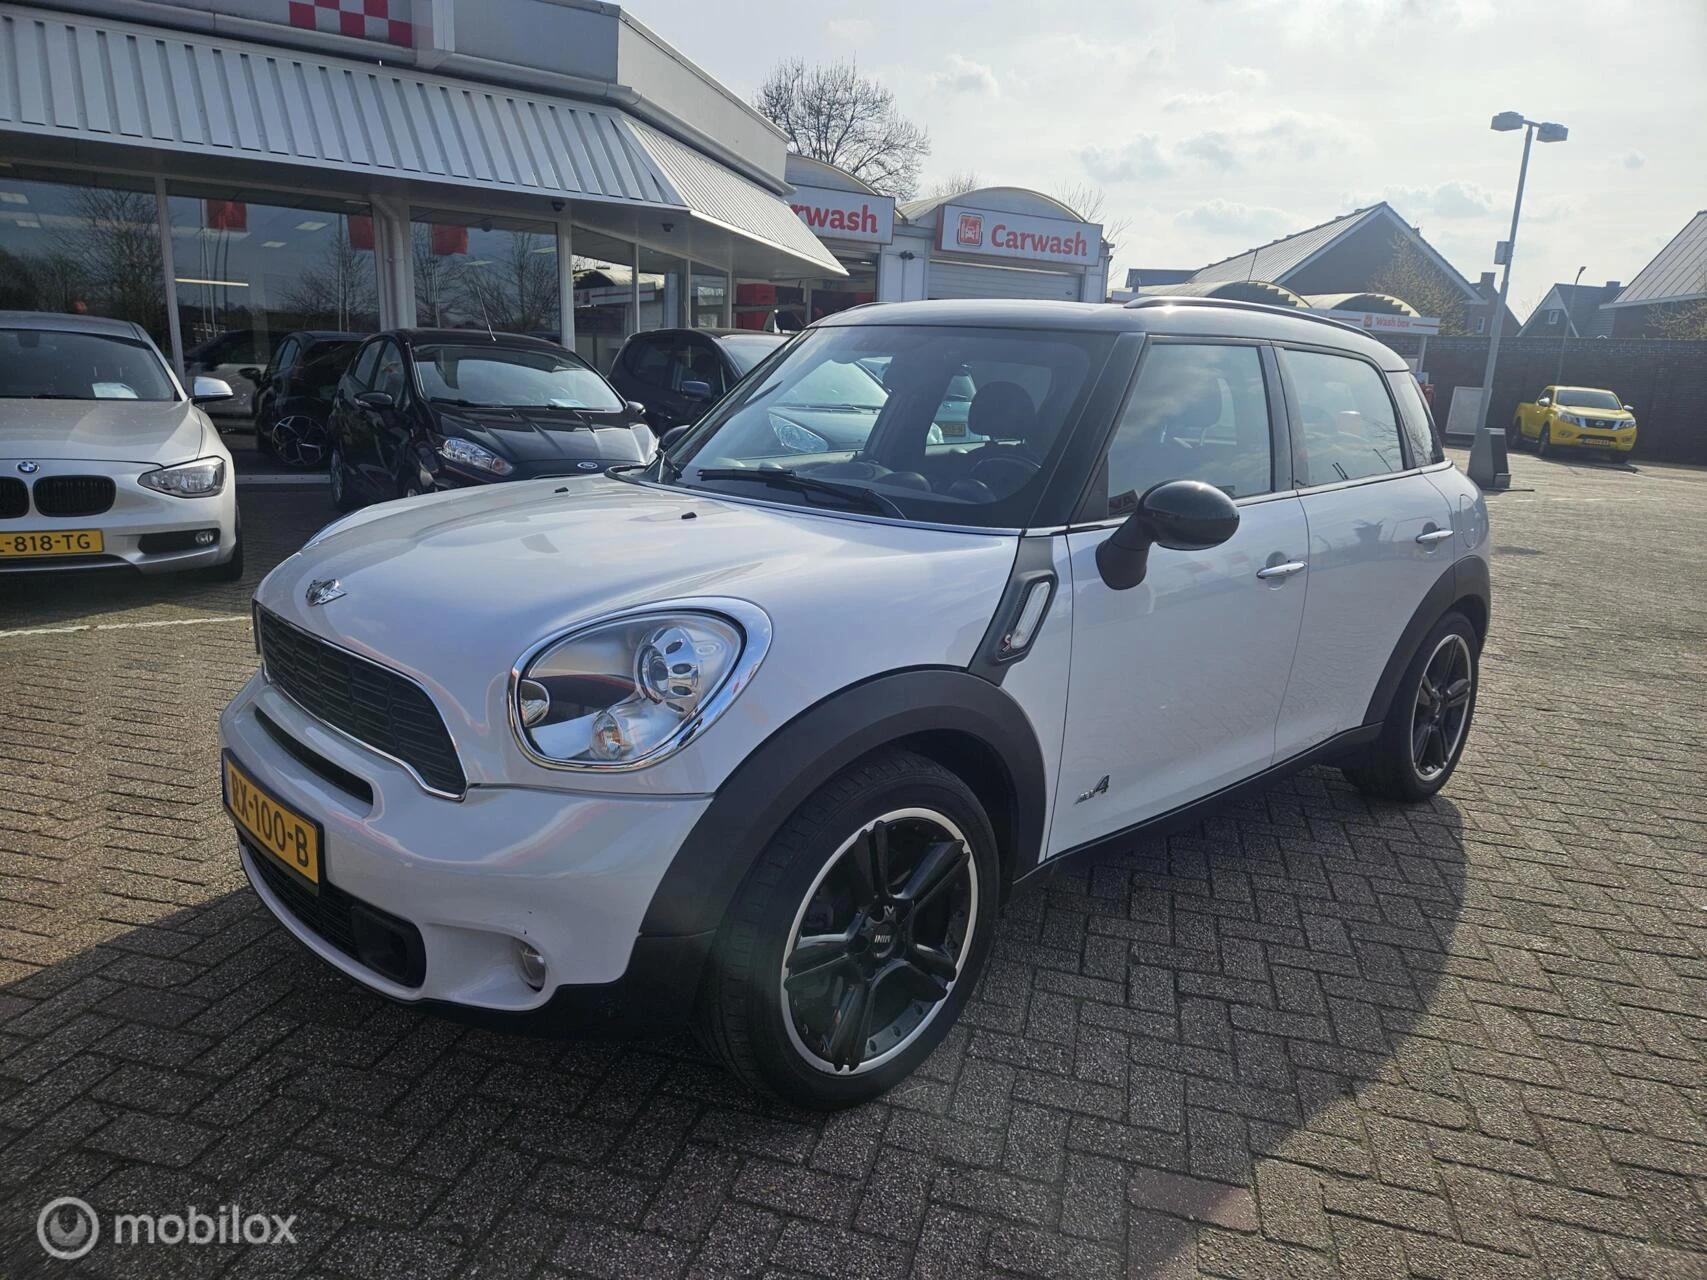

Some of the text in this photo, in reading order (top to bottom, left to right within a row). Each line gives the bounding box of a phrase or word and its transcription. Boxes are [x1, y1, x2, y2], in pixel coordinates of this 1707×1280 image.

[991, 224, 1088, 257] Carwash
[0, 533, 90, 553] -818-TG
[231, 770, 309, 868] RX-100-B
